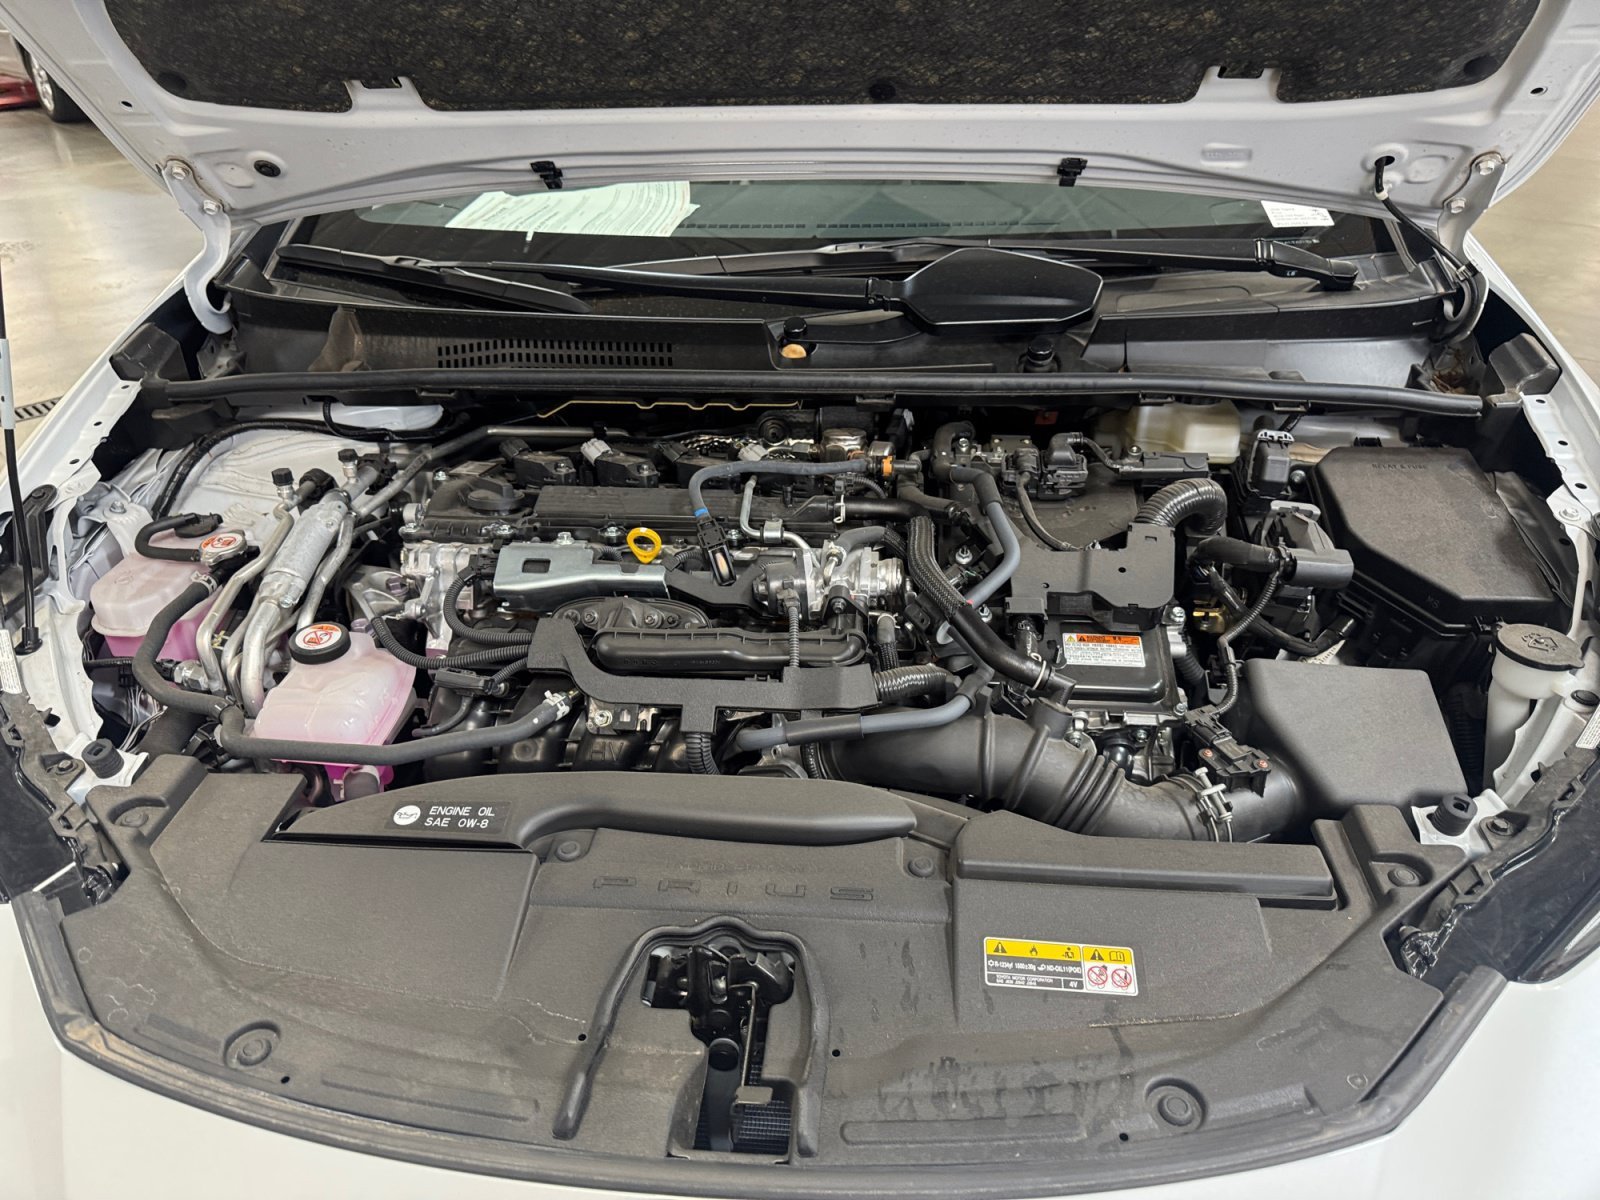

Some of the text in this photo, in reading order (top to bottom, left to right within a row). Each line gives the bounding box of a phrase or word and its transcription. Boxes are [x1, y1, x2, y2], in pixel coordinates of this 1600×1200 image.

[429, 806, 496, 817] ENGINE OIL
[424, 817, 451, 827] SAE
[592, 876, 874, 901] PRIUS
